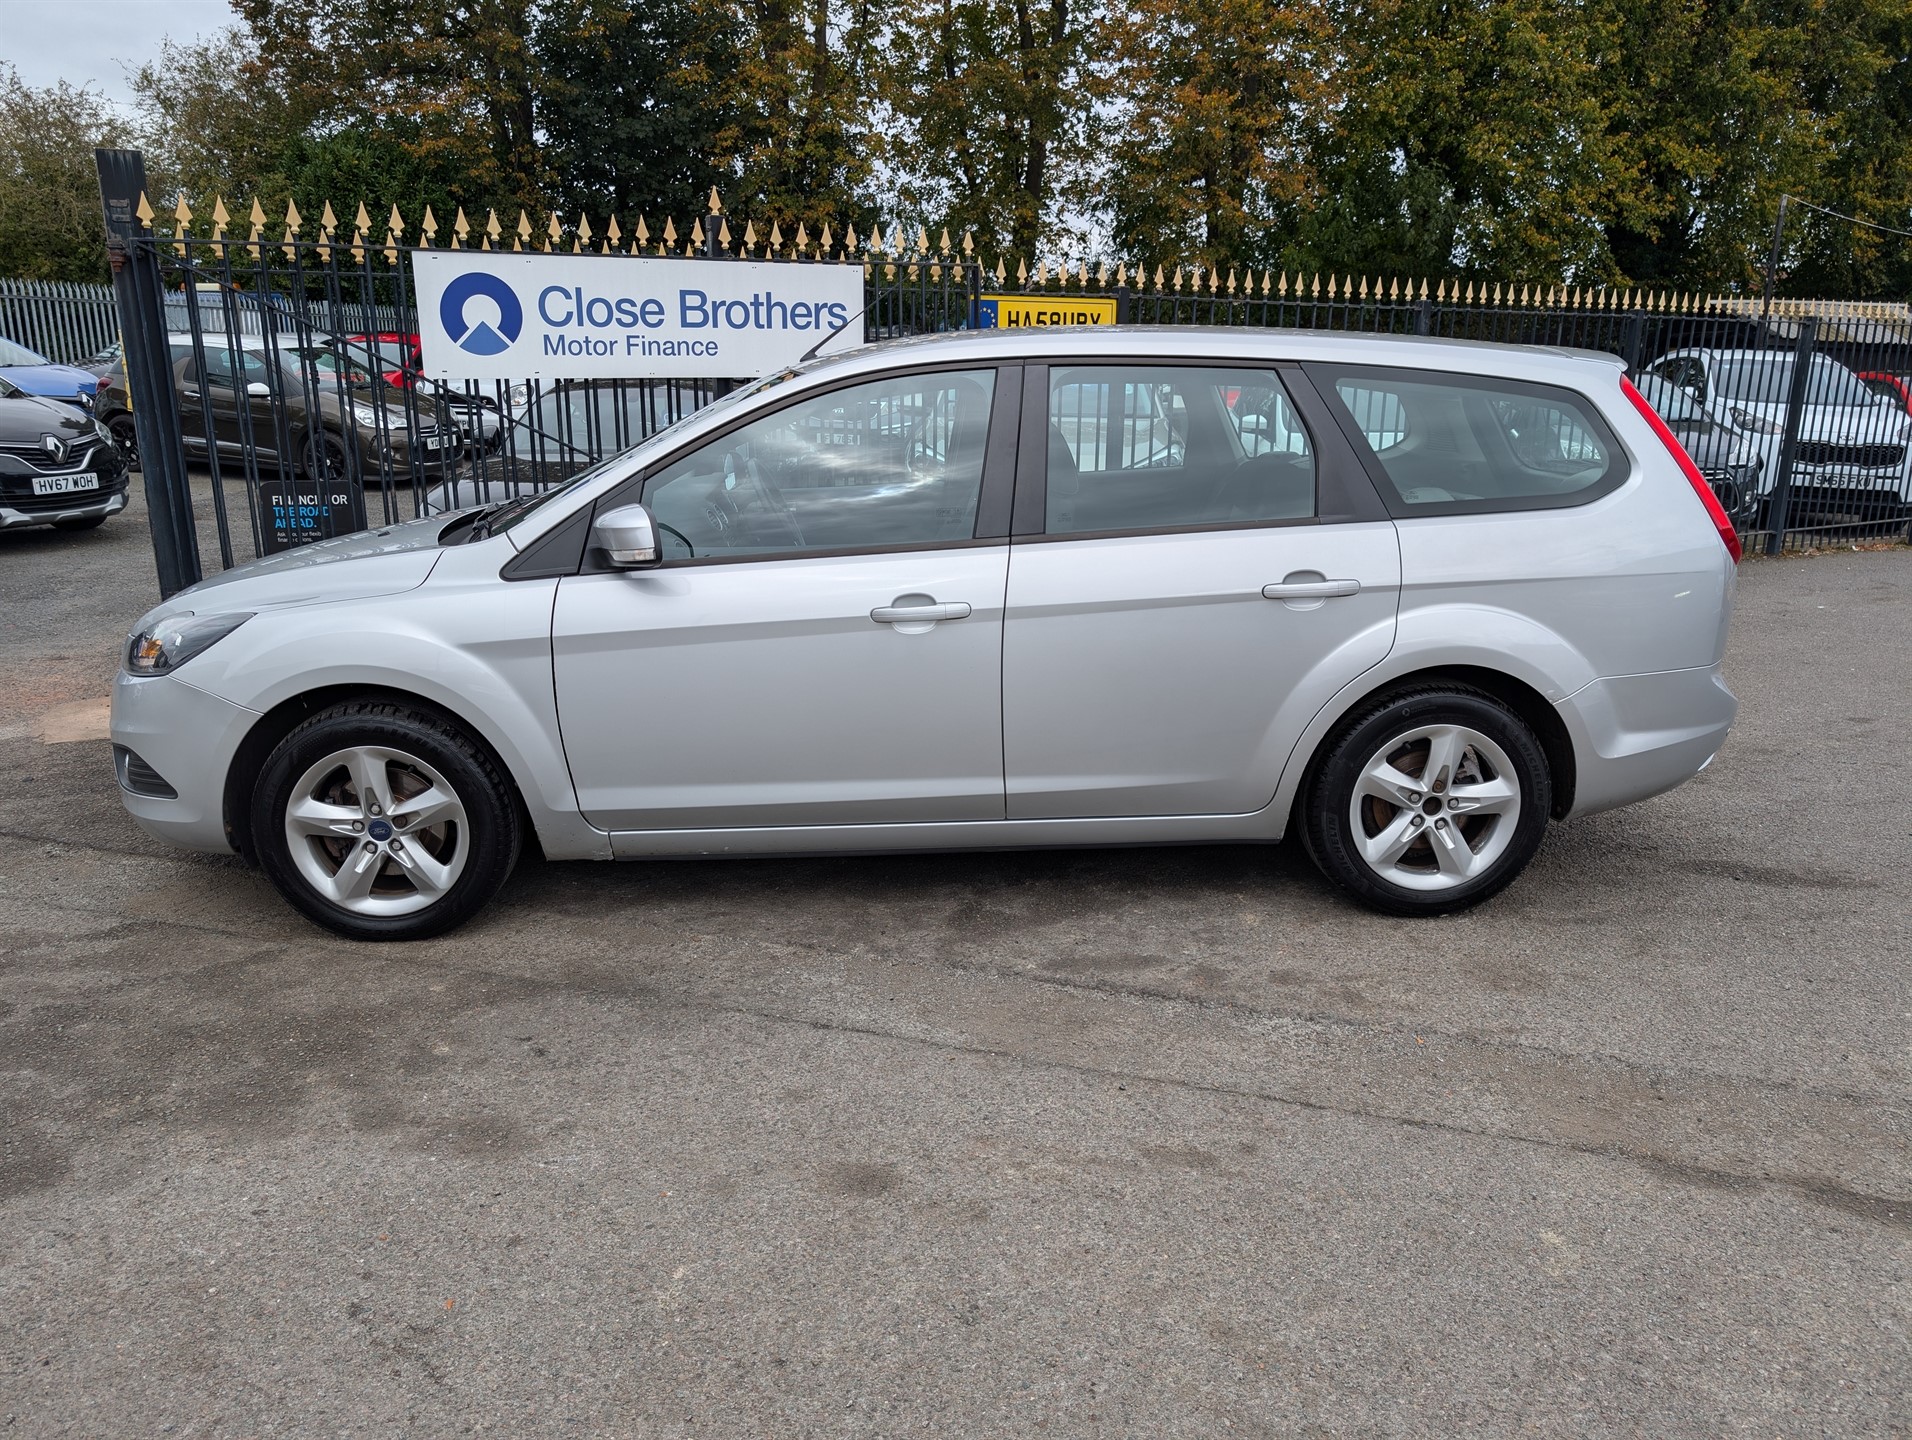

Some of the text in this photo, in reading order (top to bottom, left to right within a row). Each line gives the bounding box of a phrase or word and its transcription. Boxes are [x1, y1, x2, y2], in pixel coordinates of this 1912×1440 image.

[537, 285, 849, 331] Close Brothers
[543, 334, 719, 357] Motor Finance
[38, 475, 94, 492] HV67 WOH
